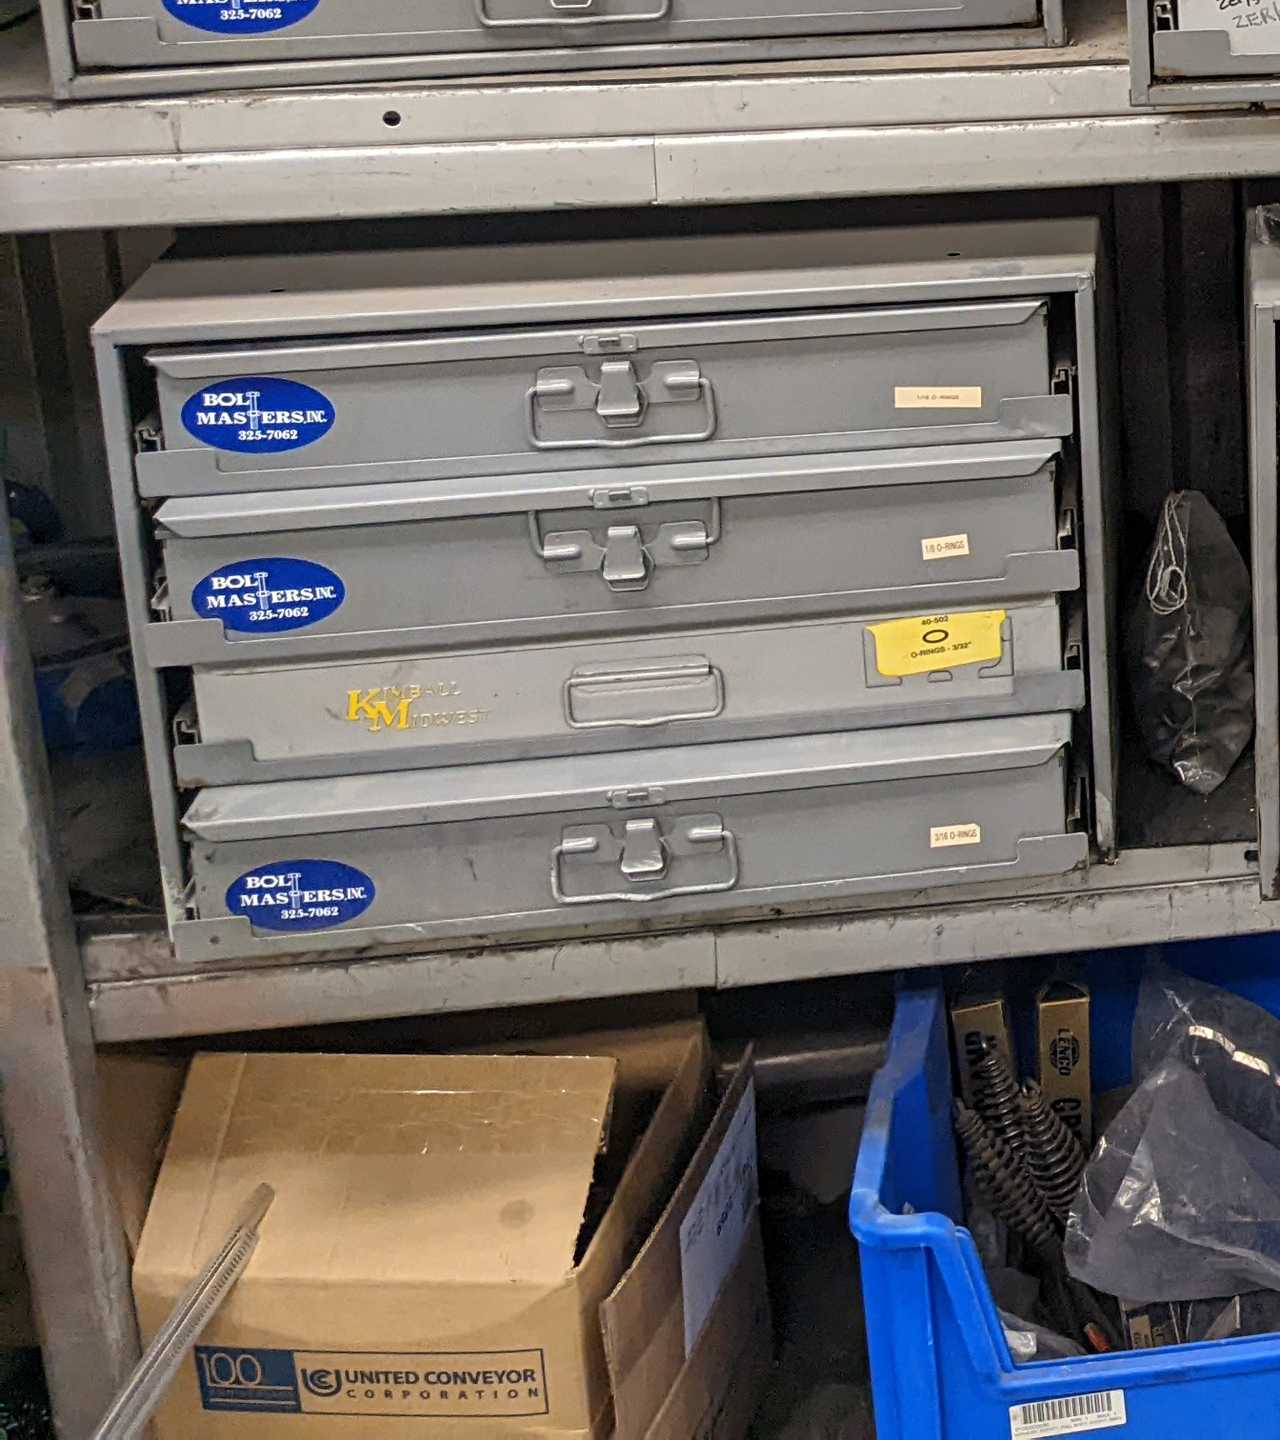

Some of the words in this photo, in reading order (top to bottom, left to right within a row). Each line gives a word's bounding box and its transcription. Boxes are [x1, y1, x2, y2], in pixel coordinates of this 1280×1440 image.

[220, 8, 281, 20] 325-7062
[238, 429, 297, 440] 325-7062
[249, 606, 308, 621] 325-7062
[280, 906, 338, 919] 325-7062
[345, 1369, 419, 1385] UNITED
[423, 1368, 536, 1385] CONVEYOR
[346, 1388, 540, 1400] CORPORATION
